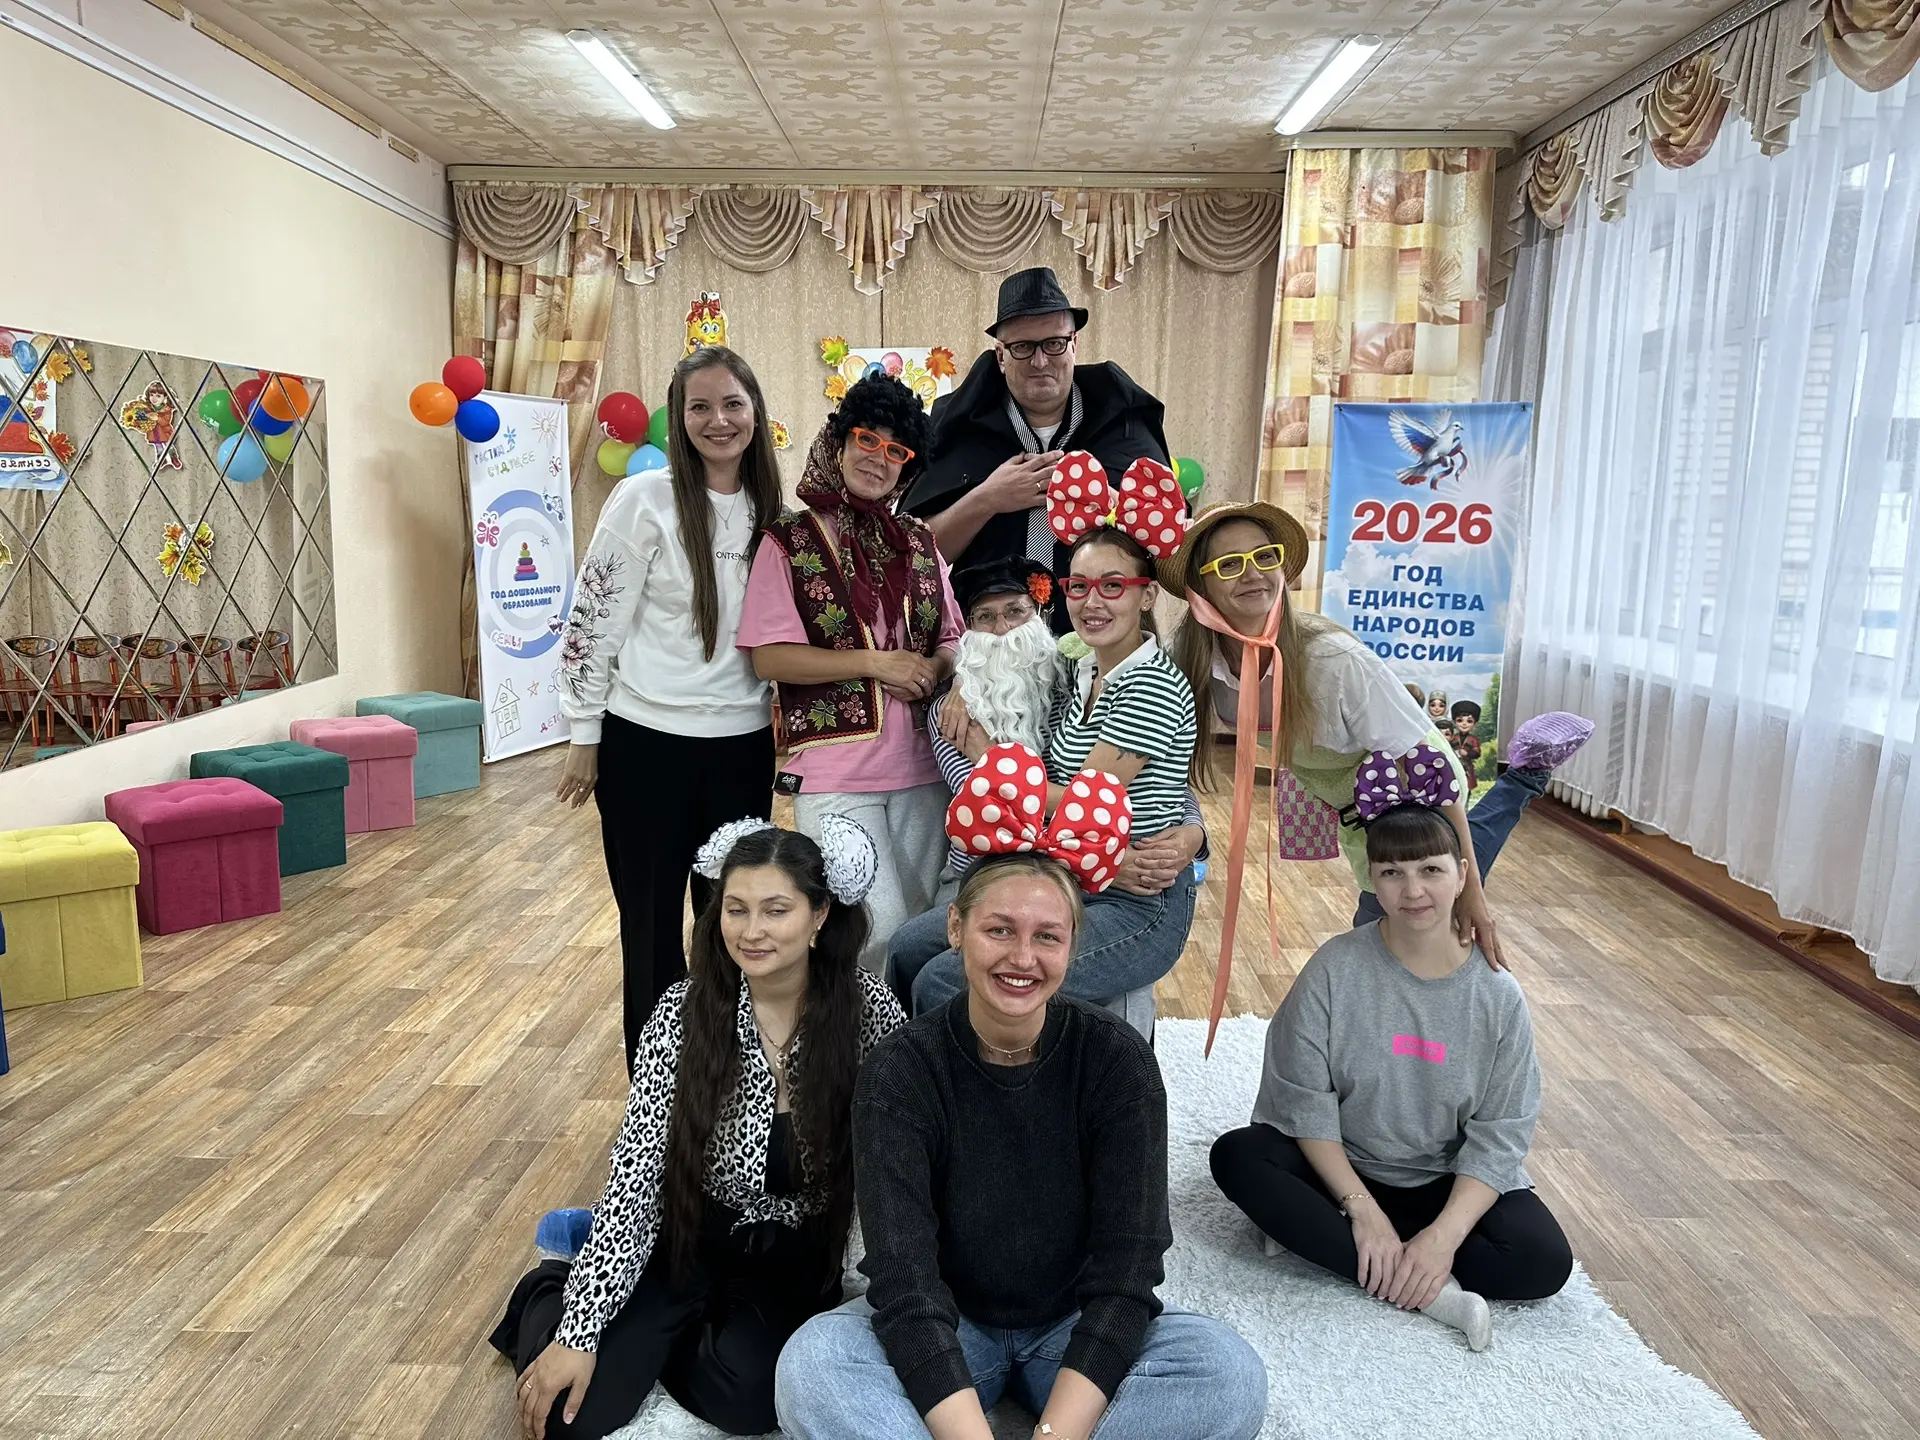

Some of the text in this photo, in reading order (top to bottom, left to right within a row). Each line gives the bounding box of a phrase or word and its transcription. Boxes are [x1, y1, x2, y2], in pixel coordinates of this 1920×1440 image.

[1351, 501, 1493, 545] 2026
[1393, 565, 1443, 586] ГОД
[490, 585, 561, 599] ГОД ДОШКОЛЬНОГО
[1347, 590, 1485, 612] ЕДИНСТВА
[502, 597, 552, 610] ОБРАЗОВАНИЯ
[1352, 615, 1476, 639] НАРОДОВ
[491, 631, 522, 648] СЕМЬЯ
